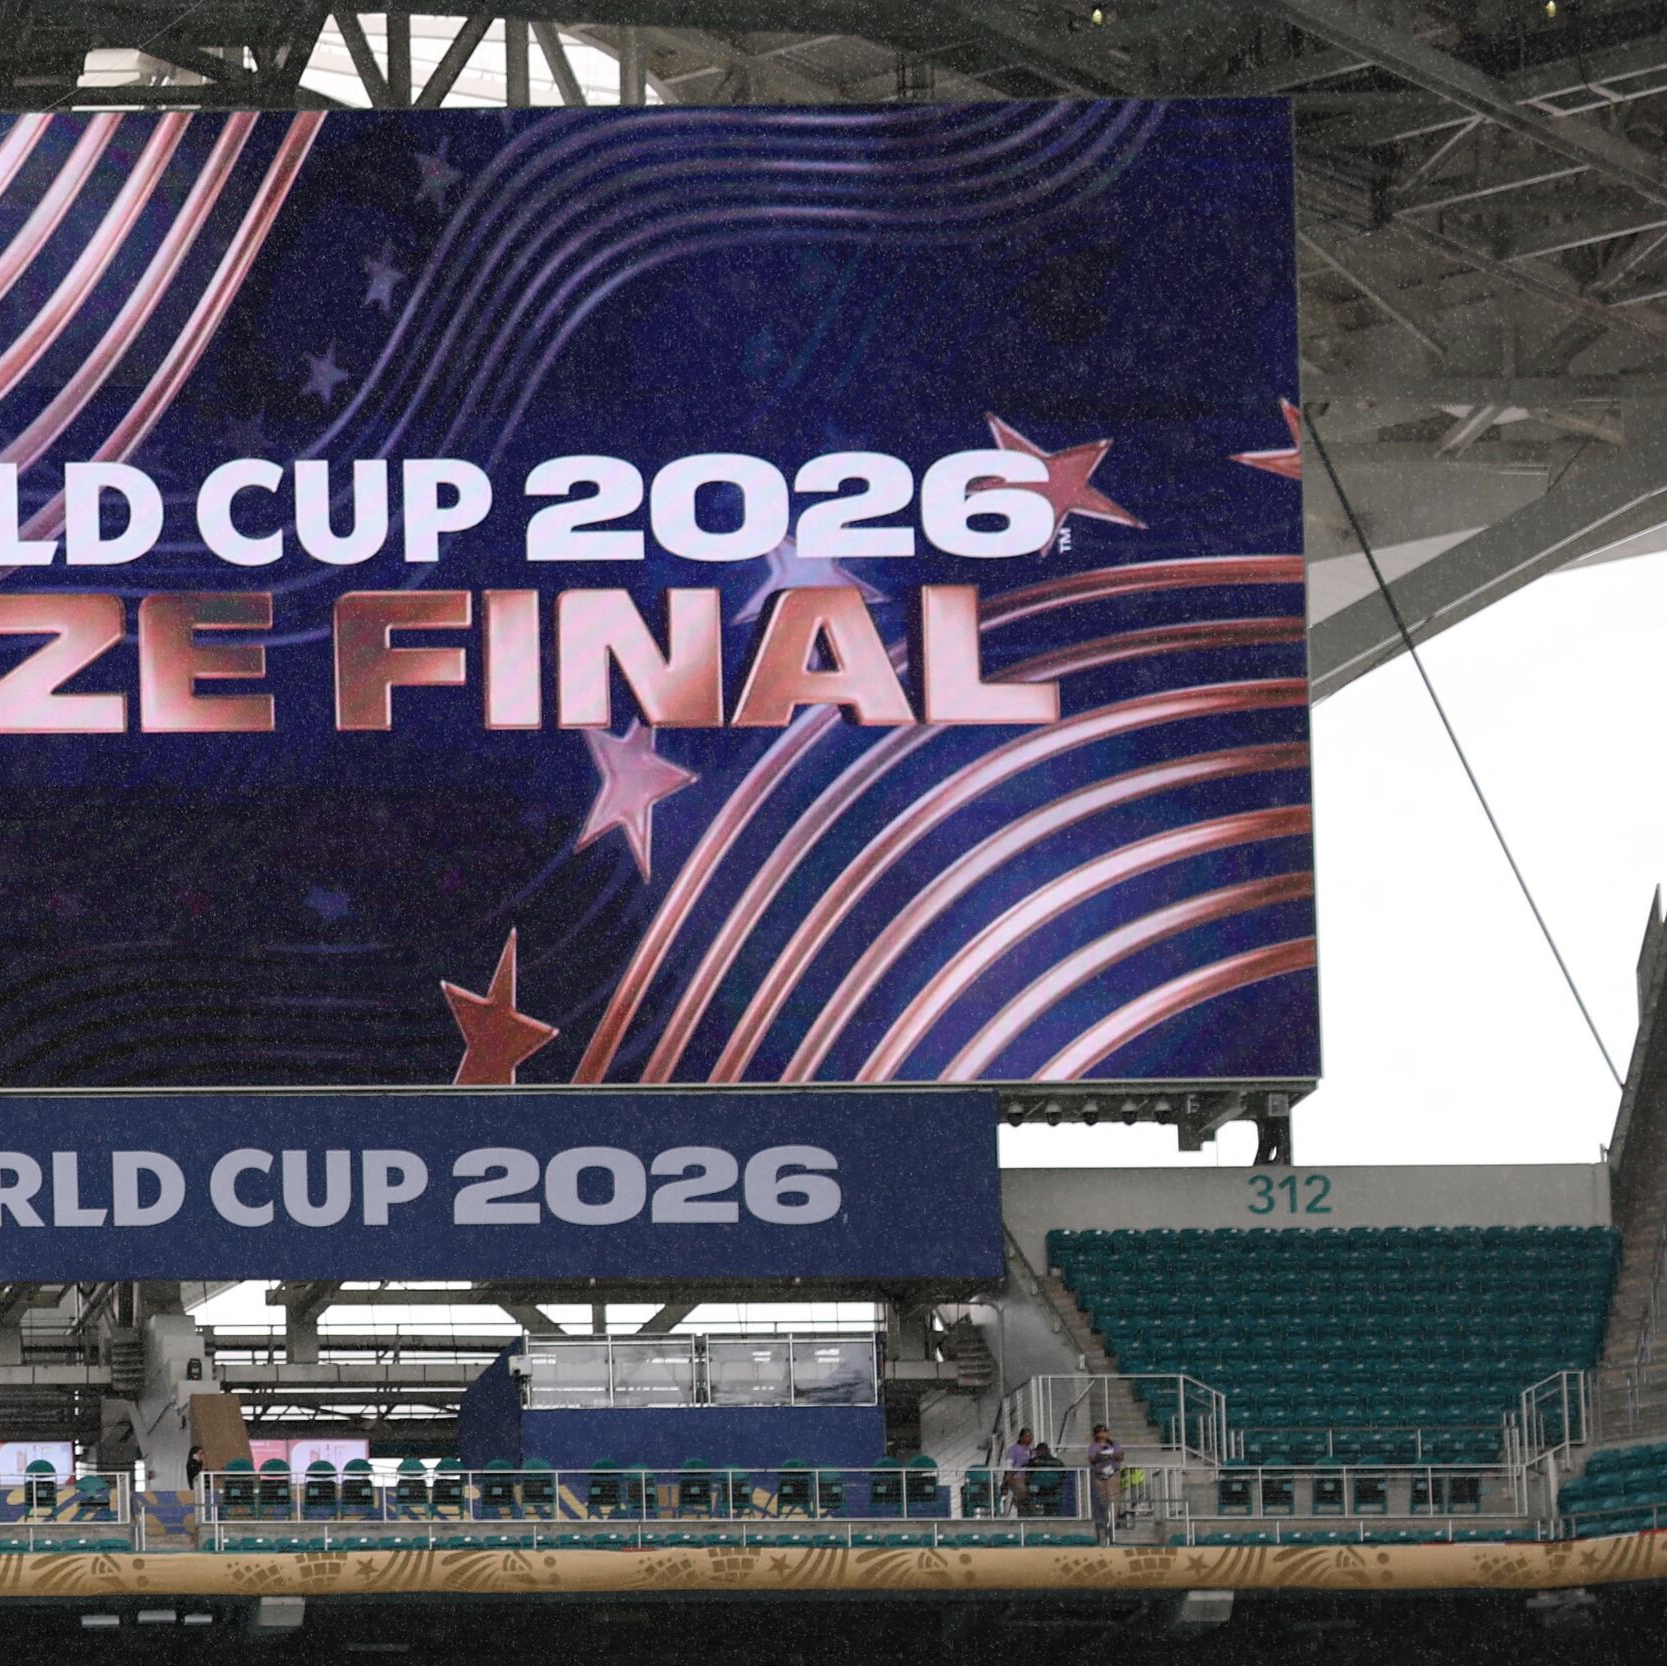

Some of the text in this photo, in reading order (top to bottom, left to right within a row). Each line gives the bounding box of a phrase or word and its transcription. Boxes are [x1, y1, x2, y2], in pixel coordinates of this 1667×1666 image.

[195, 457, 493, 567] CUP
[525, 447, 1057, 559] 2026
[333, 584, 1061, 730] FINAL
[210, 1148, 428, 1227] CUP
[453, 1145, 841, 1225] 2026
[1248, 1174, 1331, 1214] 312
